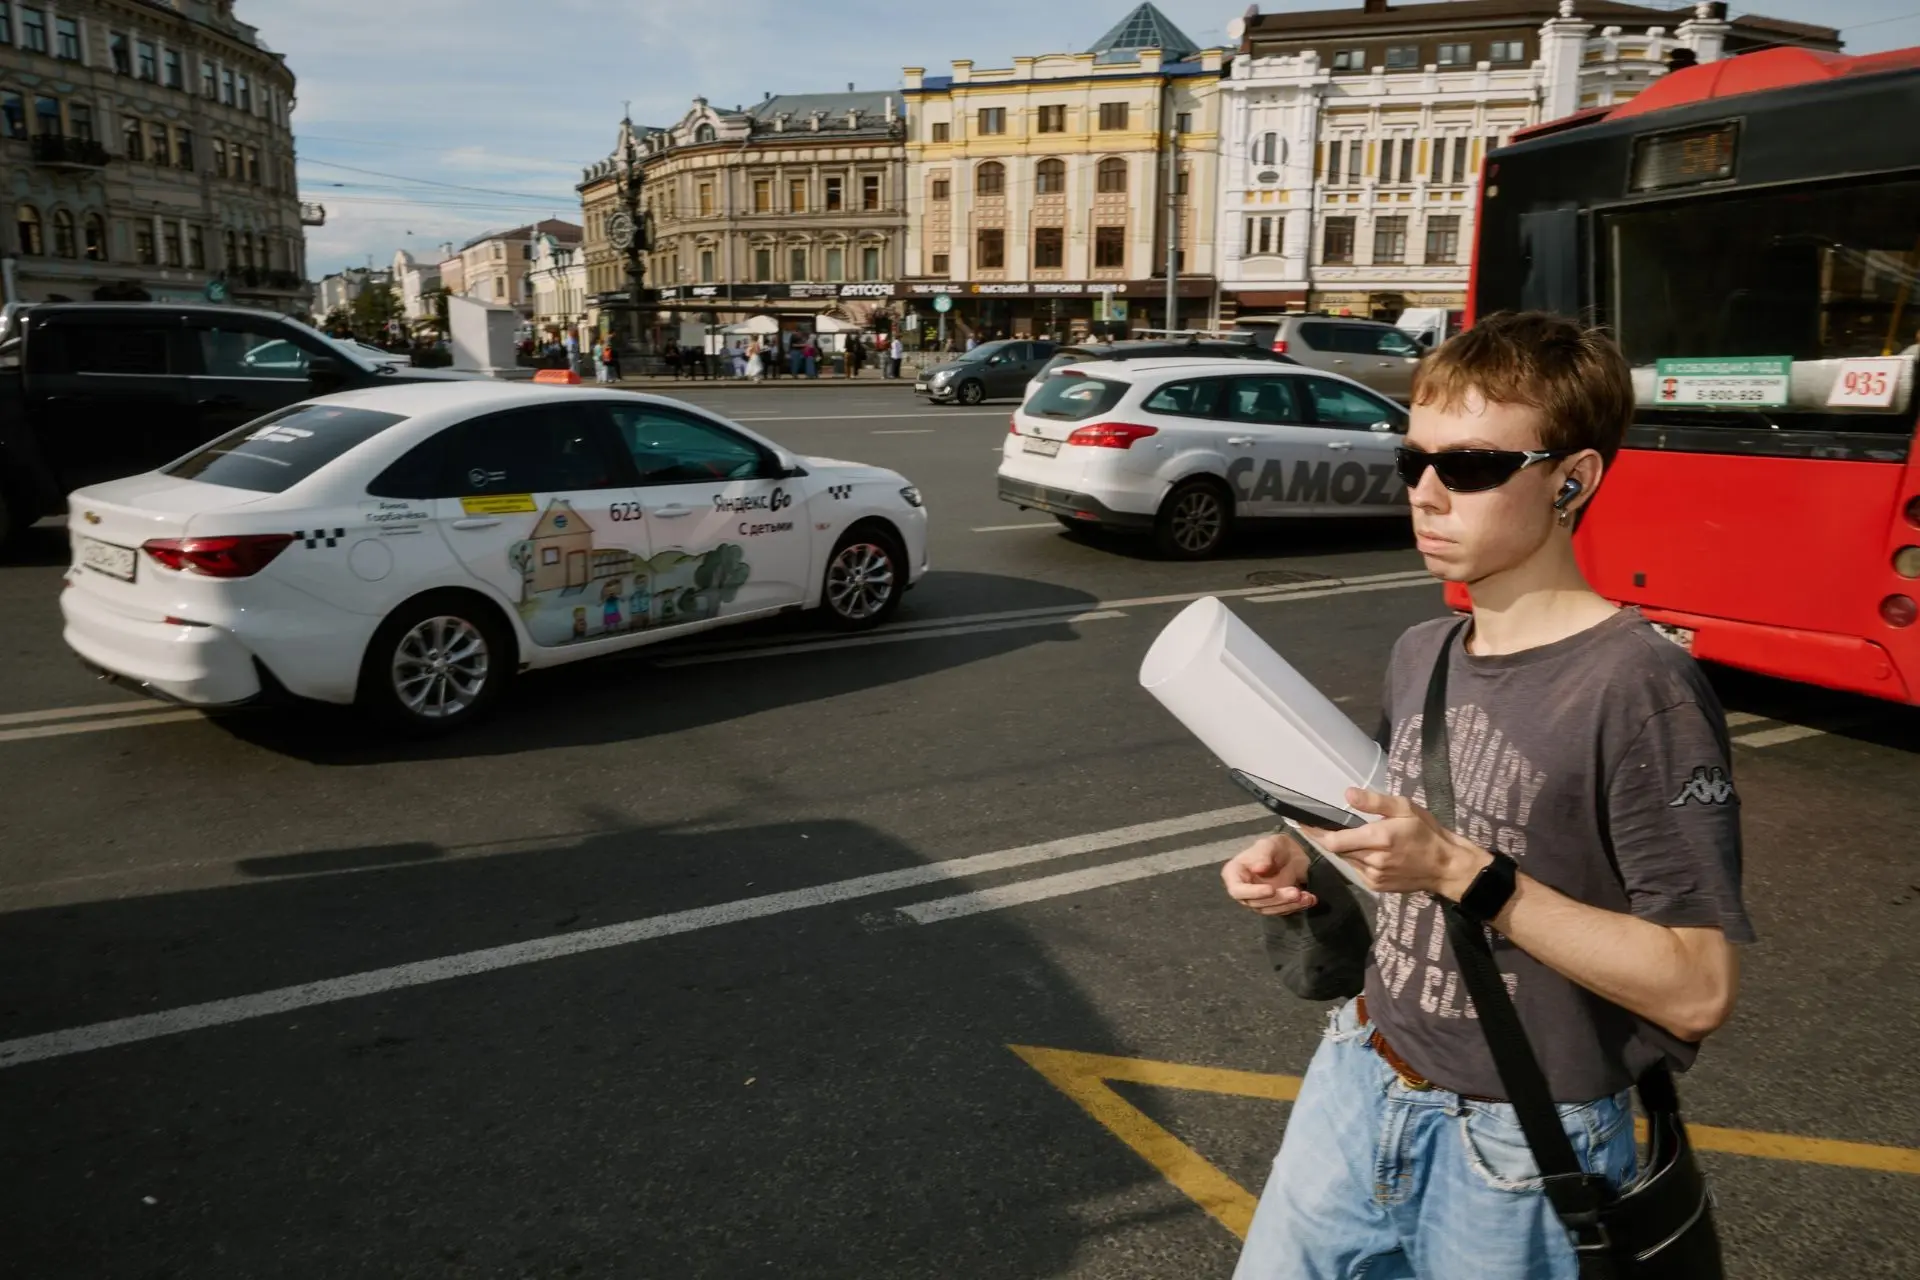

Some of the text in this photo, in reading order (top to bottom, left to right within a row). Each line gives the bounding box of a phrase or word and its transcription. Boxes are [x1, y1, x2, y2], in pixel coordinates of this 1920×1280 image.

[840, 284, 895, 296] ARTCORE
[1844, 371, 1888, 396] 935
[713, 487, 792, 514] Яндекс Go
[609, 502, 642, 521] 623
[748, 521, 793, 537] детьми
